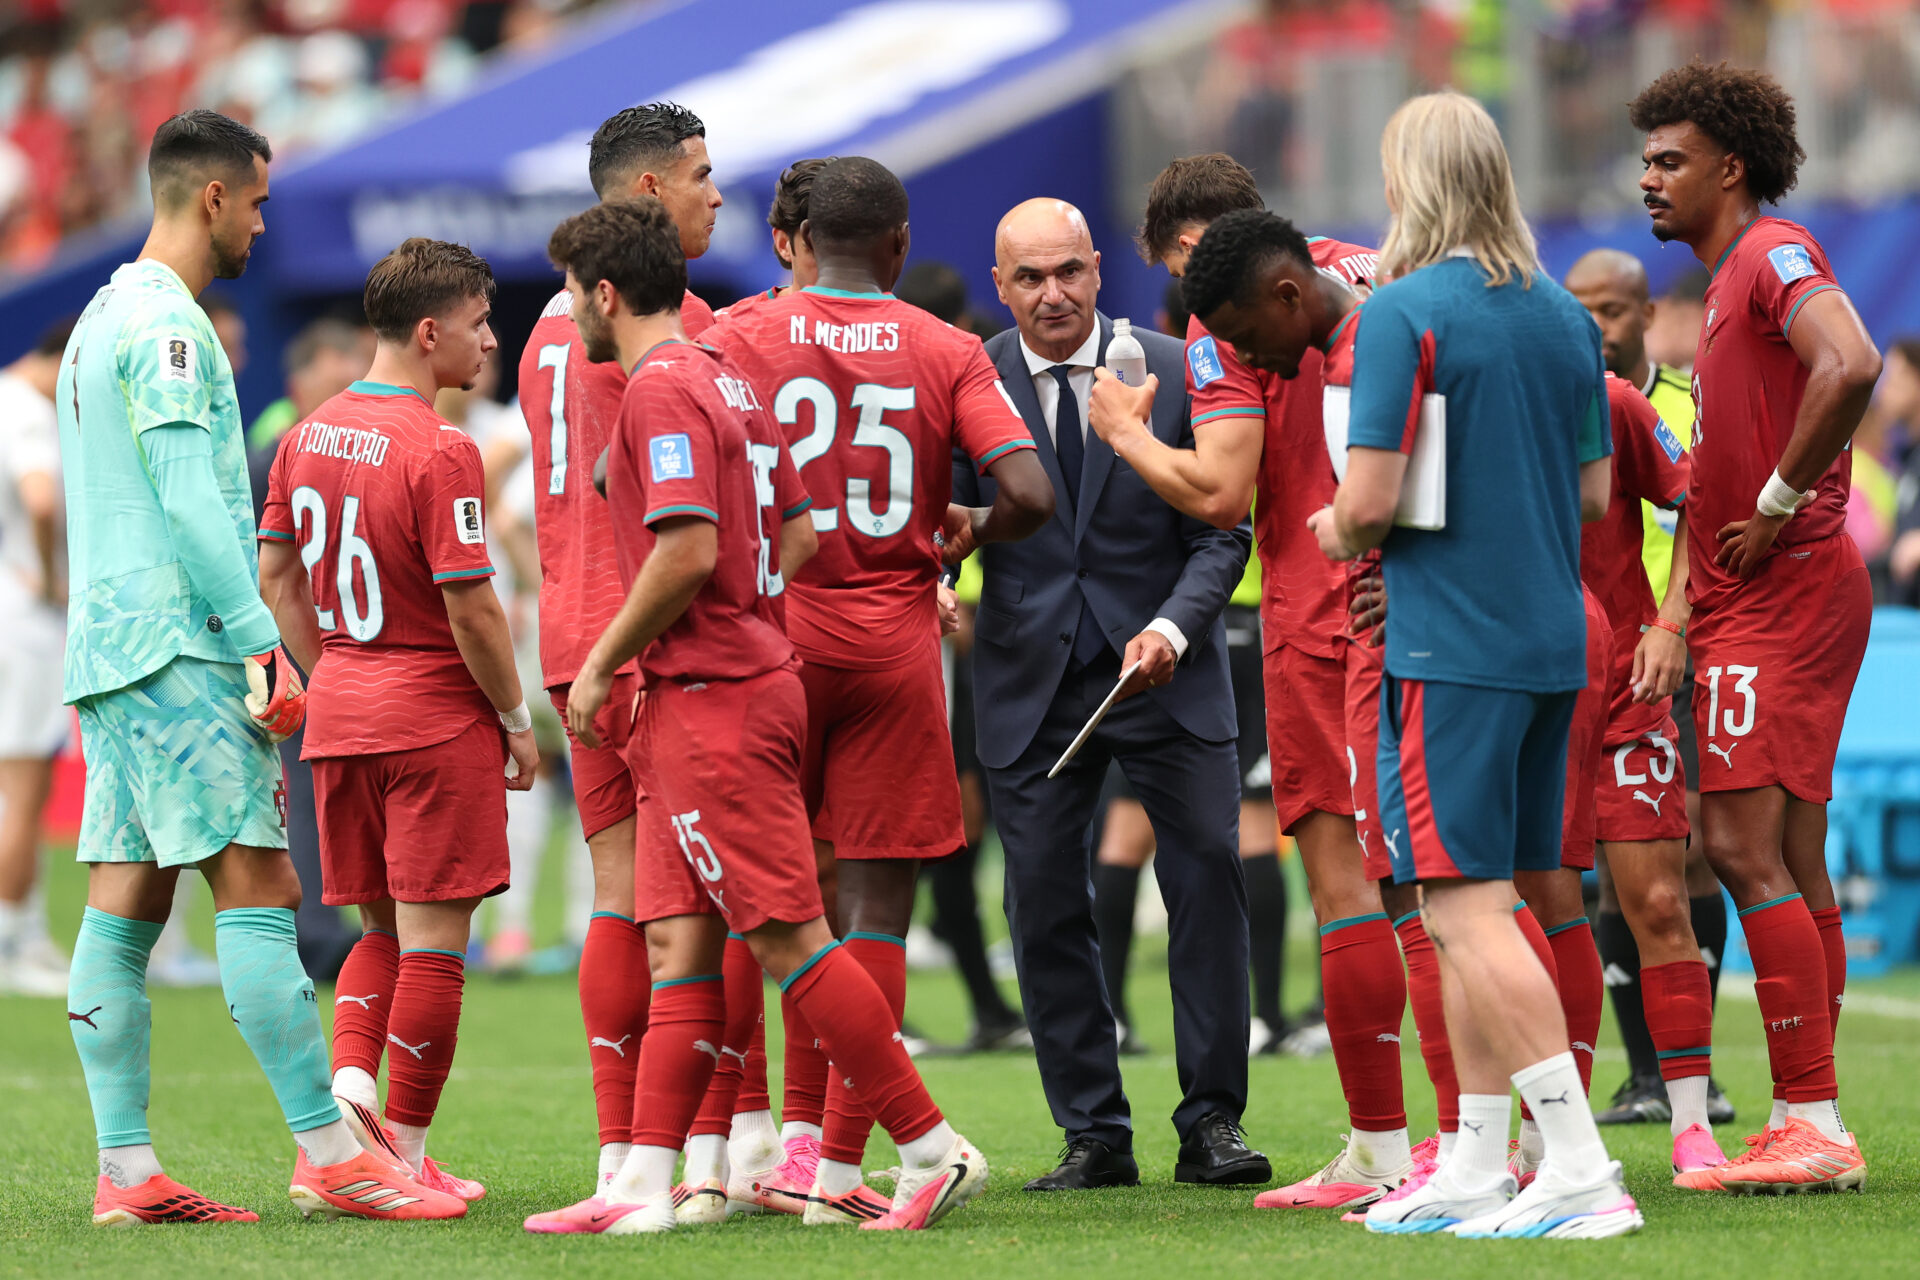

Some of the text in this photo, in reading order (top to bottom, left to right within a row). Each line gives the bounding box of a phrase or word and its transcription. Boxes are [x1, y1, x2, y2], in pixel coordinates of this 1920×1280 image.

[790, 315, 899, 354] N. MENDES
[305, 421, 391, 467] CONCEIÇÃO
[537, 340, 572, 495] 7
[773, 375, 916, 538] 25
[291, 485, 385, 642] 26
[1705, 664, 1759, 737] 13
[671, 808, 723, 884] 15
